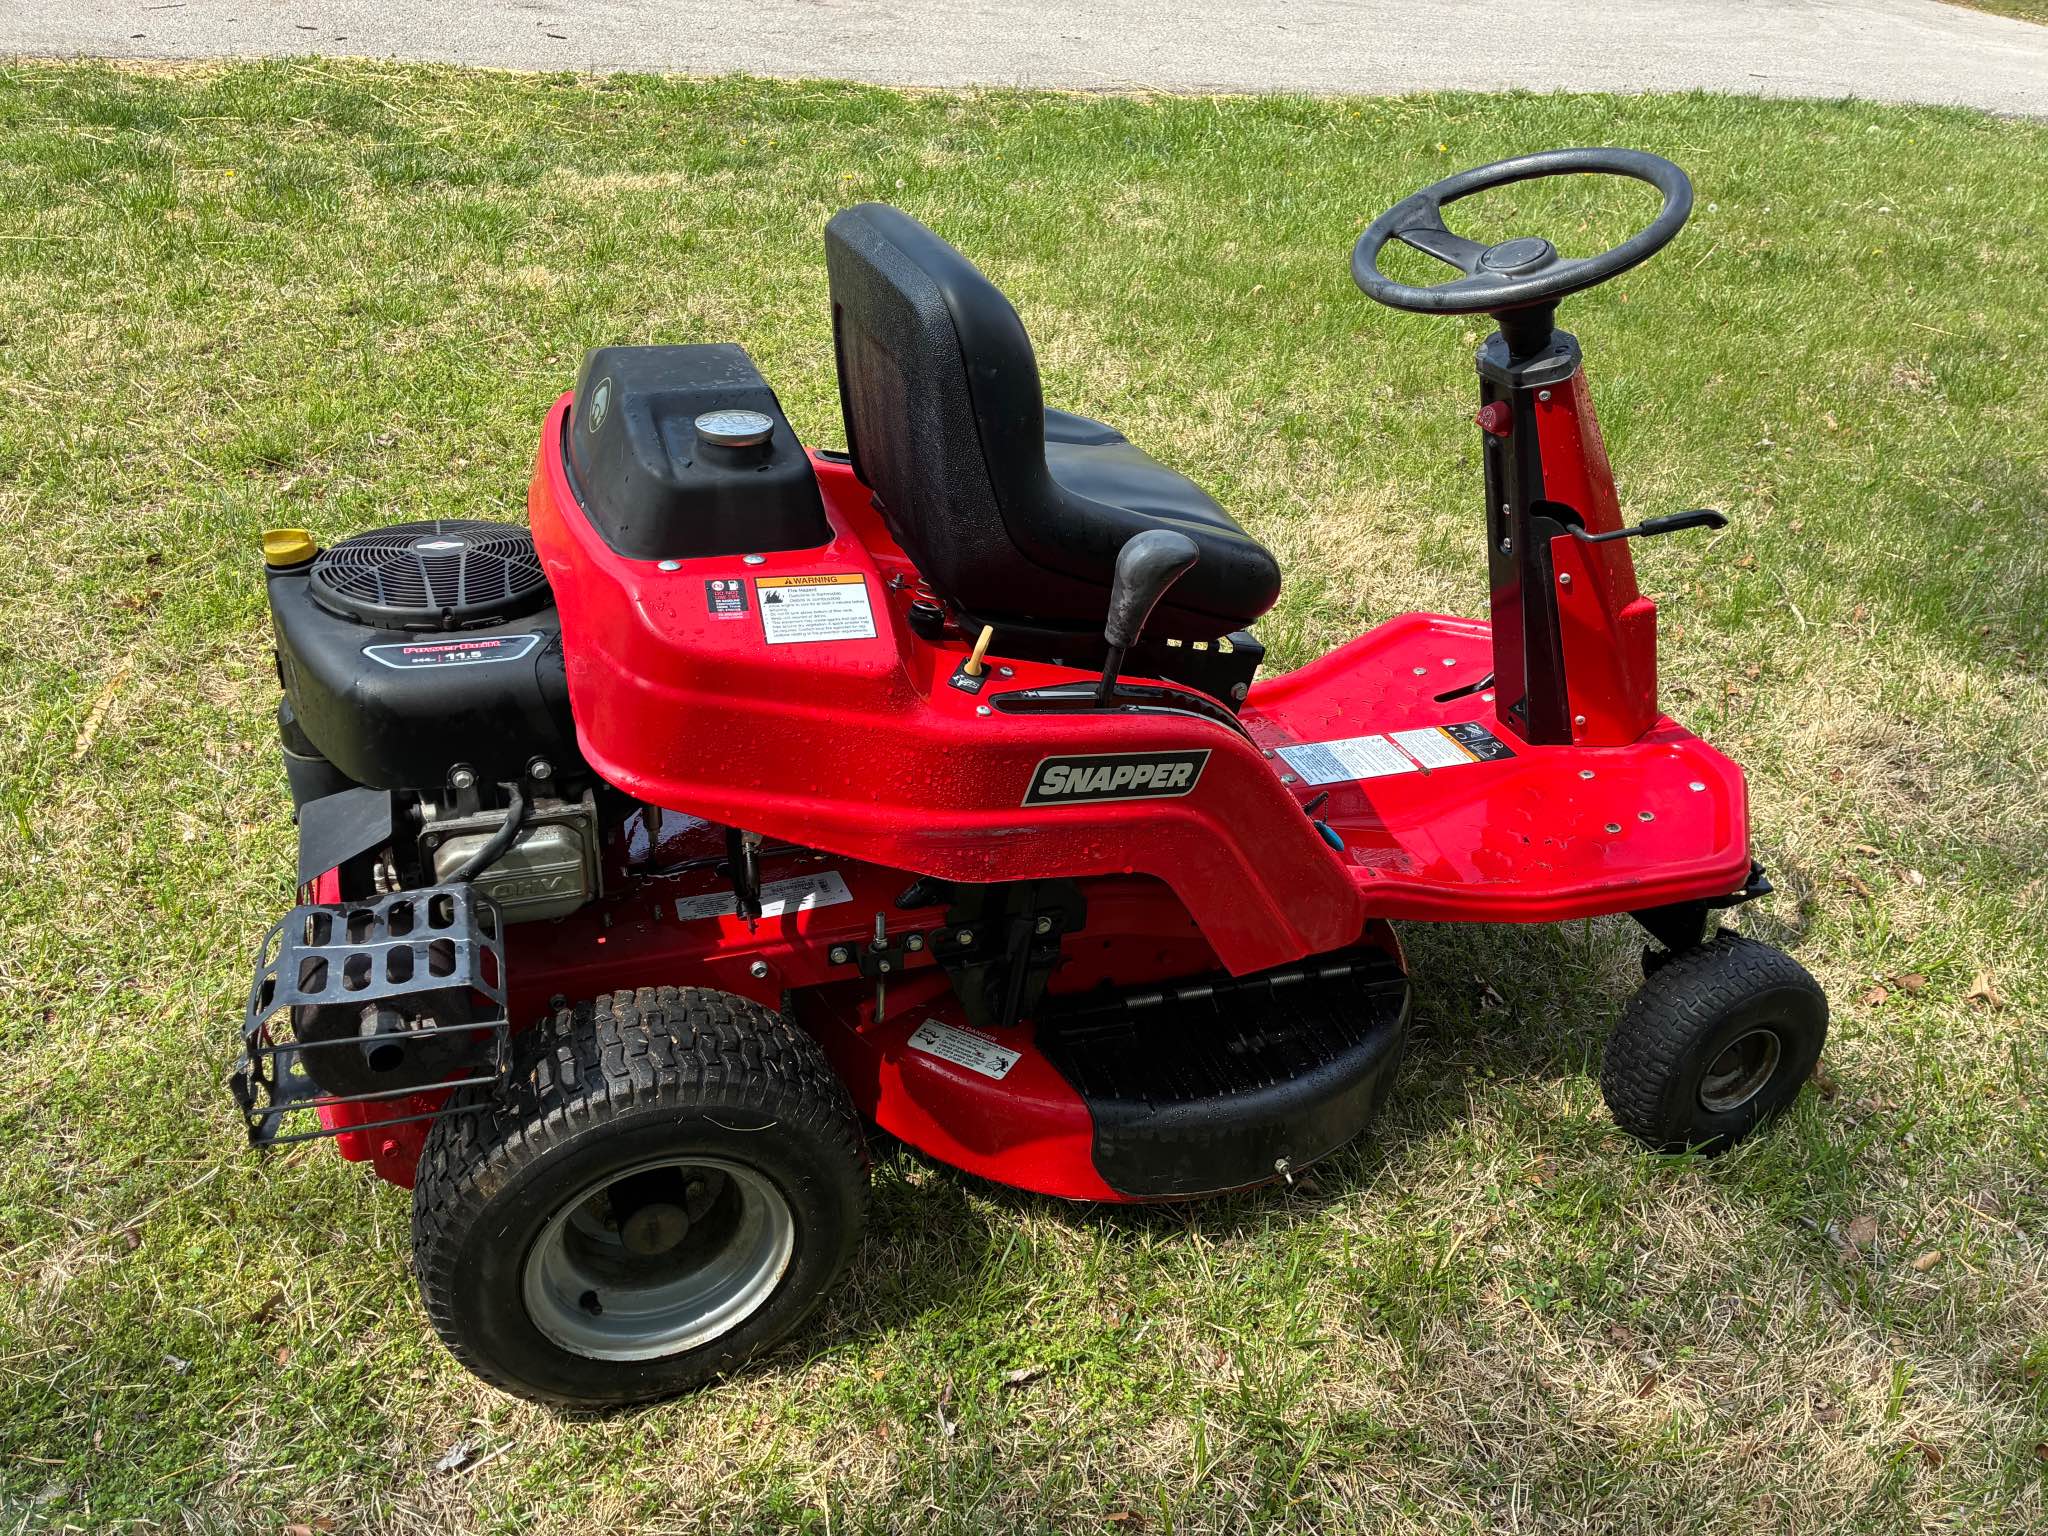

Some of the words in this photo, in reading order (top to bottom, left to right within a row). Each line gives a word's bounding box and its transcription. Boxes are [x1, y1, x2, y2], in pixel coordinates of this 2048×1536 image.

[793, 576, 838, 585] WARNING
[445, 651, 481, 660] 11.5
[1039, 763, 1194, 795] SNAPPER
[492, 876, 562, 897] OHV
[965, 1026, 998, 1041] DANGER
